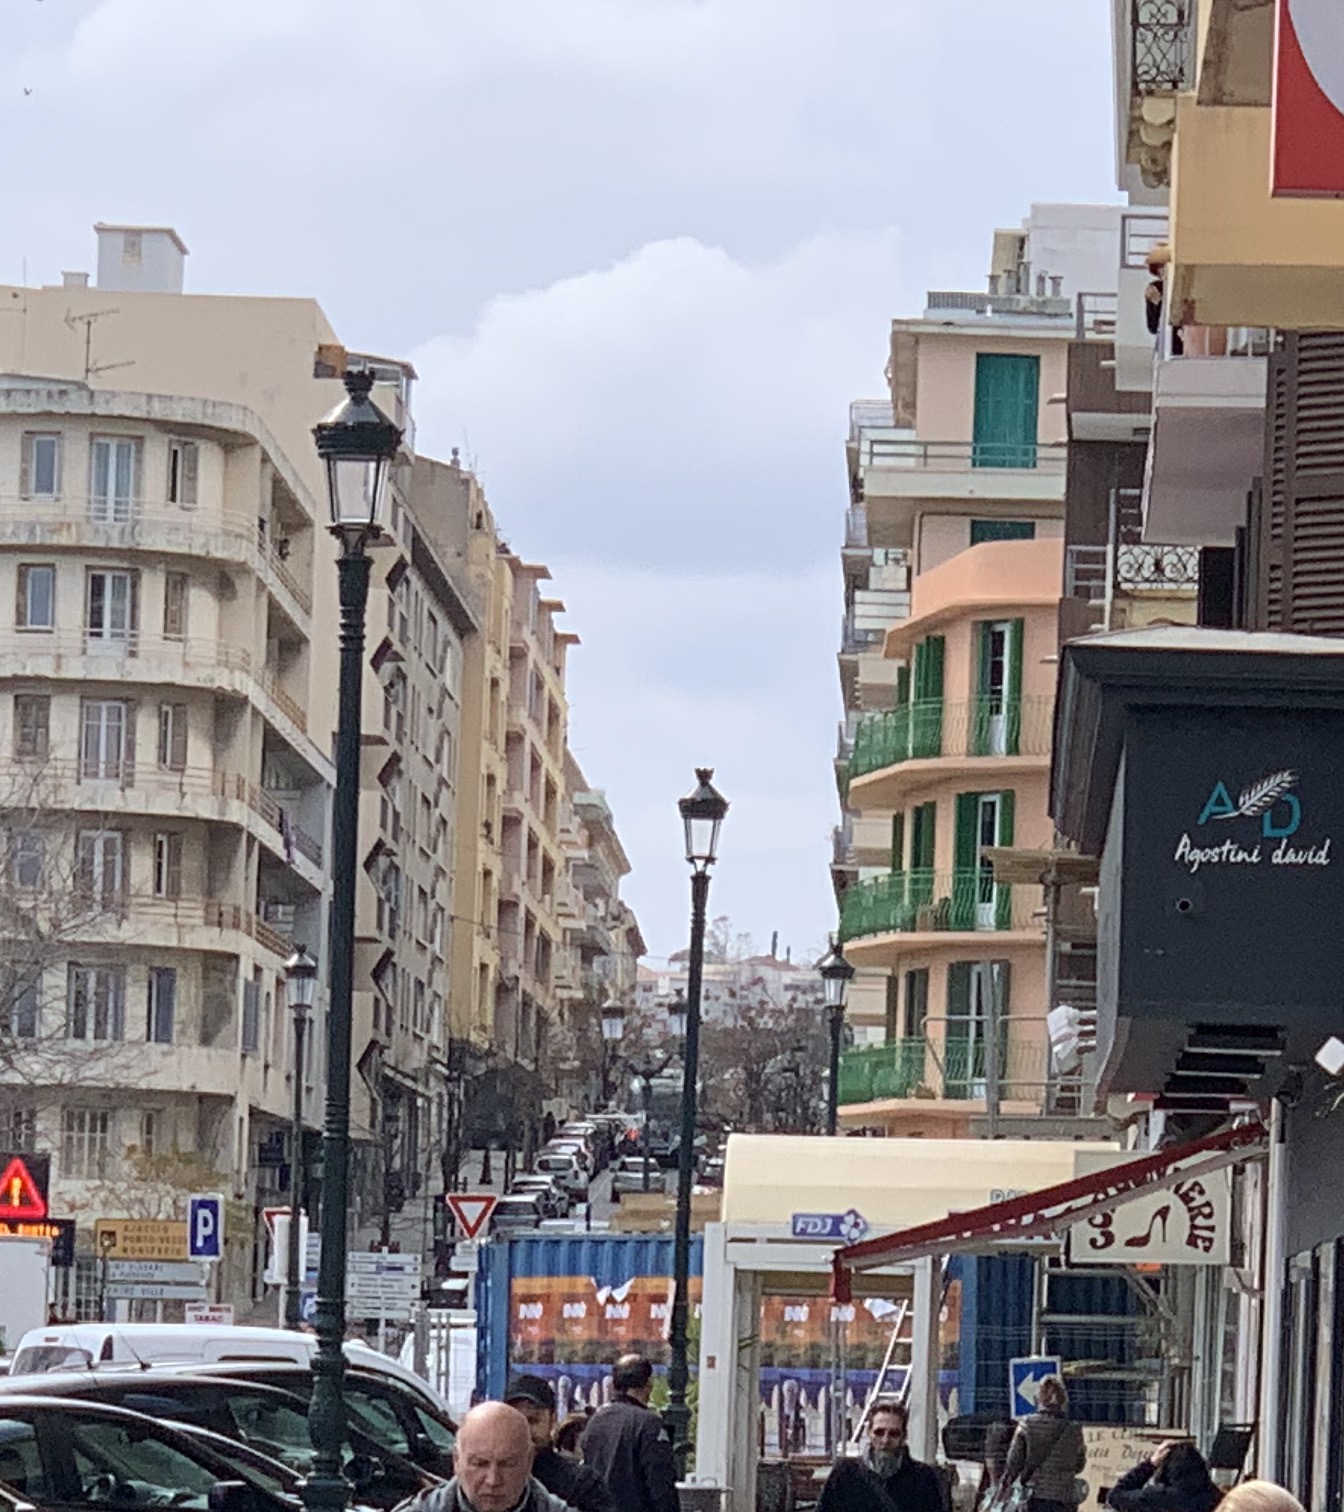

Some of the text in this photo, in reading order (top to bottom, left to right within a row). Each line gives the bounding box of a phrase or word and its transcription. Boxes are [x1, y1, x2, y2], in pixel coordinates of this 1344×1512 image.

[1174, 833, 1331, 873] Agostini david
[196, 1208, 214, 1248] P
[795, 1216, 833, 1235] FDJ
